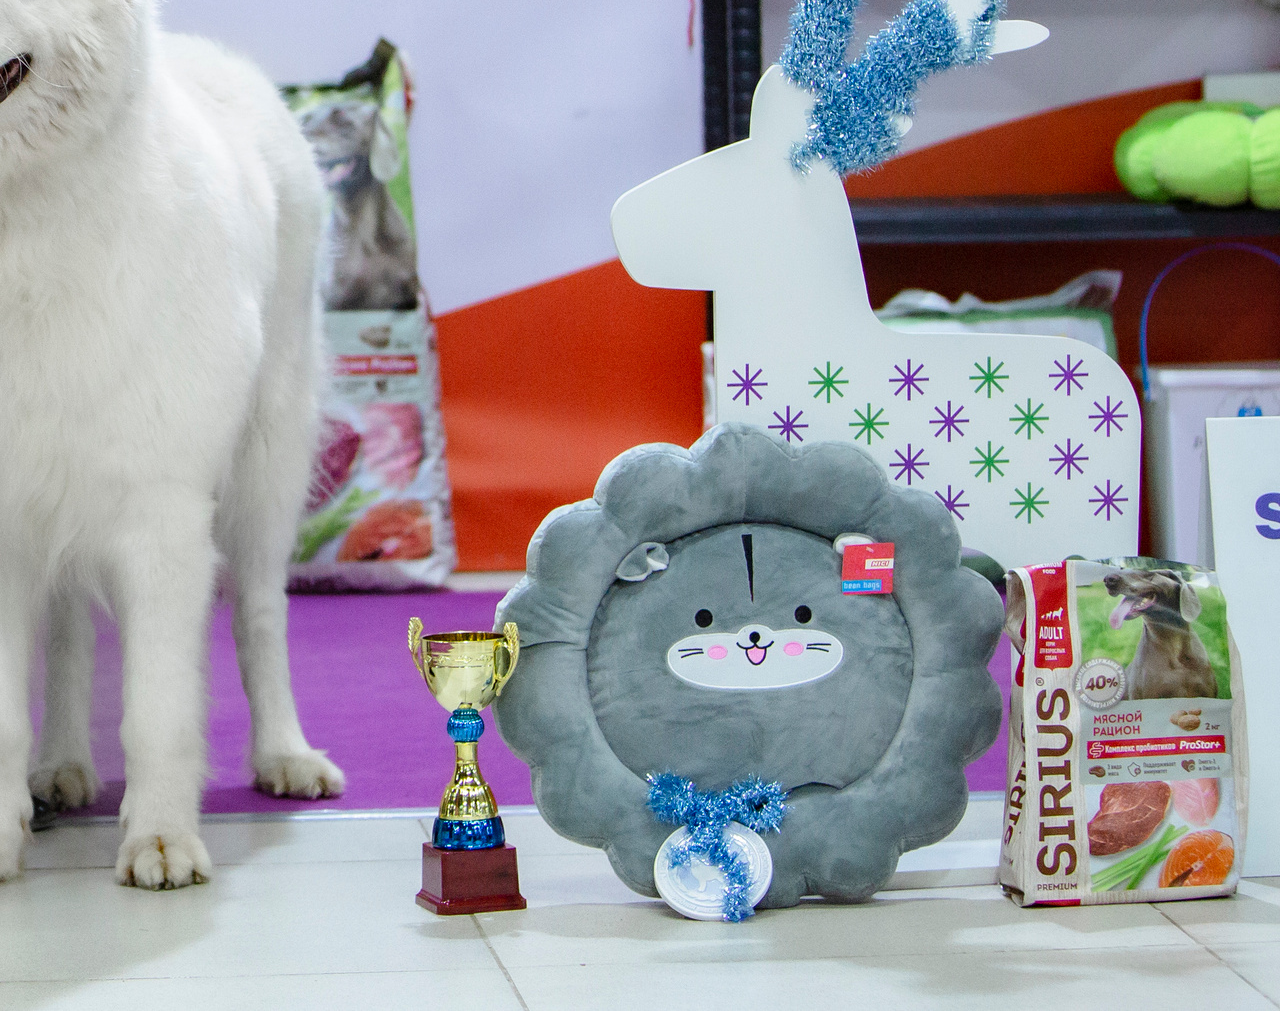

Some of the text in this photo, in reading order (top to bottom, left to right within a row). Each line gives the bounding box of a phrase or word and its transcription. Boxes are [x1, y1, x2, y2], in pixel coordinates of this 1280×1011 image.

[1039, 626, 1064, 640] ADULT
[1085, 675, 1118, 691] 40%
[1093, 710, 1143, 724] МЯСНОЙ
[1093, 725, 1141, 737] РАЦИОН
[1036, 688, 1077, 875] SIRIUS
[1037, 882, 1078, 891] PREMIUM
